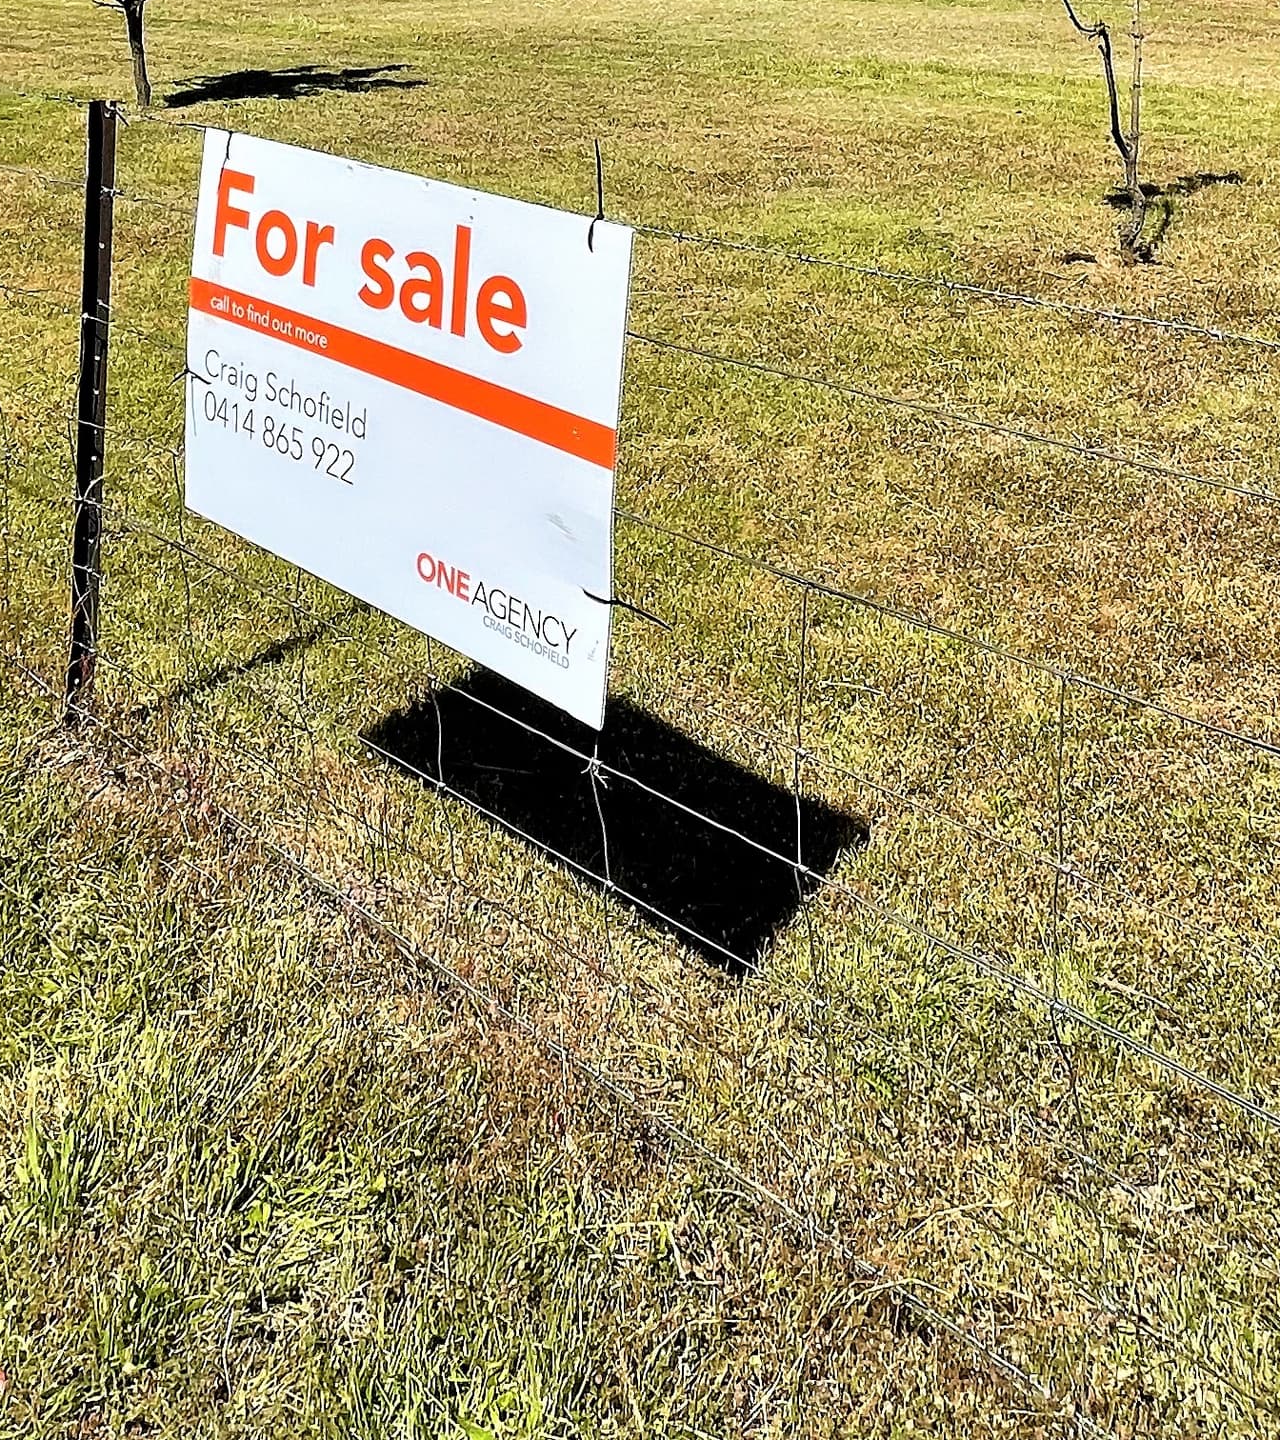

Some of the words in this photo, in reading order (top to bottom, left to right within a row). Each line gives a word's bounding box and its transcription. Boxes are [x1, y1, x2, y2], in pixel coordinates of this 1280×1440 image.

[212, 168, 335, 287] For
[357, 224, 528, 354] sale
[210, 295, 229, 311] call
[232, 301, 244, 318] to
[247, 305, 270, 327] find
[271, 318, 294, 337] out
[295, 326, 328, 349] more
[204, 349, 258, 401] Craig
[264, 371, 367, 440] Schofield
[204, 390, 255, 440] 0414
[262, 415, 303, 460] 865
[311, 436, 354, 485] 922
[482, 615, 513, 640] CRAIG
[514, 630, 570, 669] SCHOFIELD
